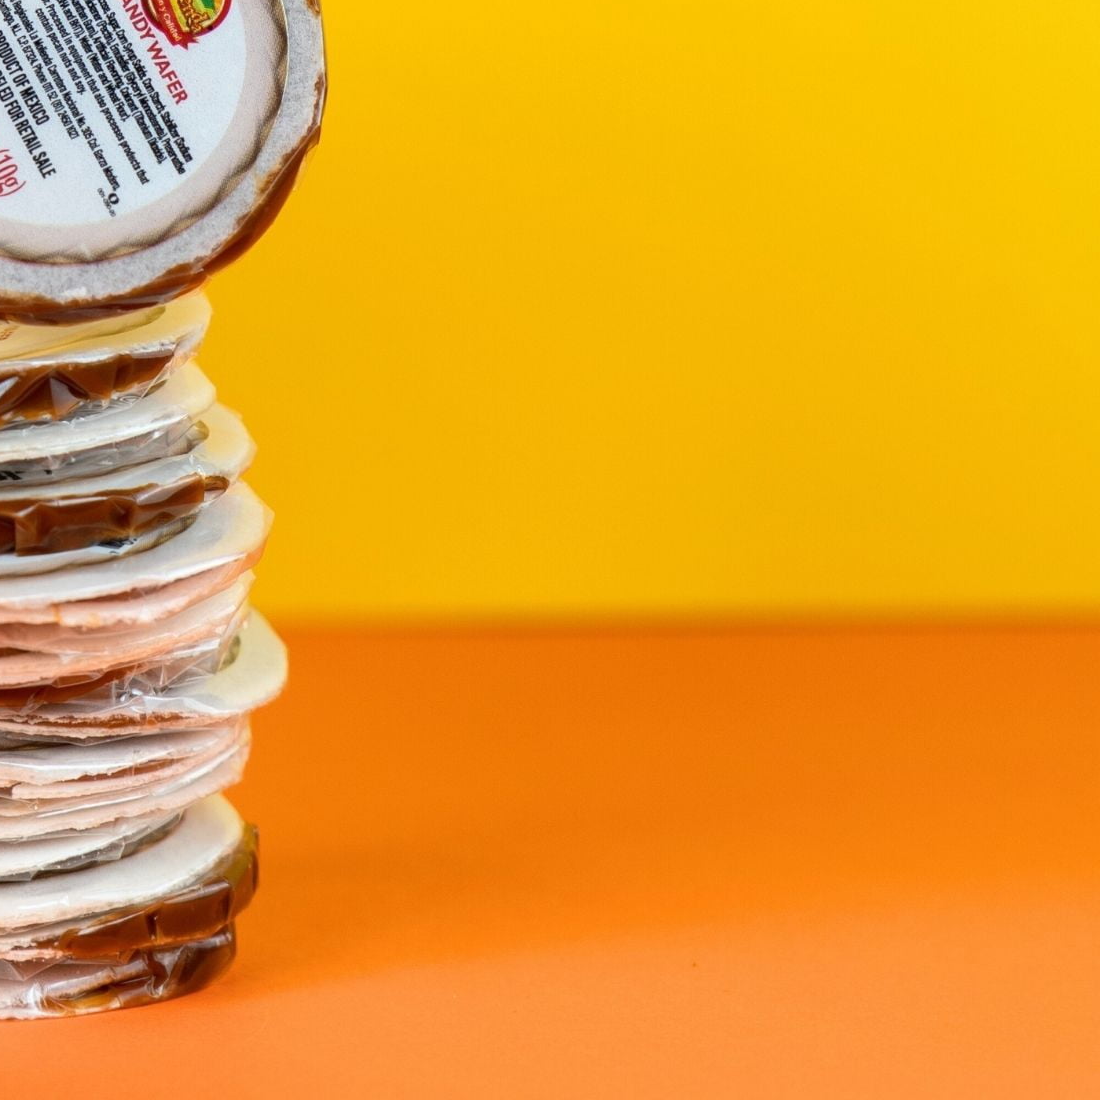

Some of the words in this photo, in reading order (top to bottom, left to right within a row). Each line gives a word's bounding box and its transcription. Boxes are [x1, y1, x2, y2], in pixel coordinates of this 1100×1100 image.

[45, 3, 70, 38] Processed
[162, 12, 182, 41] Calidad
[34, 7, 53, 33] contain
[45, 31, 64, 53] pecan
[59, 51, 74, 68] nuts
[67, 67, 81, 81] and
[74, 80, 86, 95] soy.
[63, 35, 72, 45] in
[11, 0, 34, 33] Regionales
[28, 29, 38, 40] La
[33, 38, 53, 66] Molienda
[46, 64, 67, 93] Carretera
[61, 90, 83, 118] Nacional
[67, 44, 92, 80] equipment
[146, 39, 187, 104] WAFER
[12, 73, 30, 87] OF
[86, 78, 100, 94] that
[19, 85, 49, 125] MEXICO
[93, 92, 106, 108] also
[3, 99, 25, 122] FOR
[14, 118, 42, 155] RETAIL
[32, 151, 56, 178] SALE
[99, 106, 124, 141] processes
[117, 140, 140, 170] products
[136, 168, 150, 184] that
